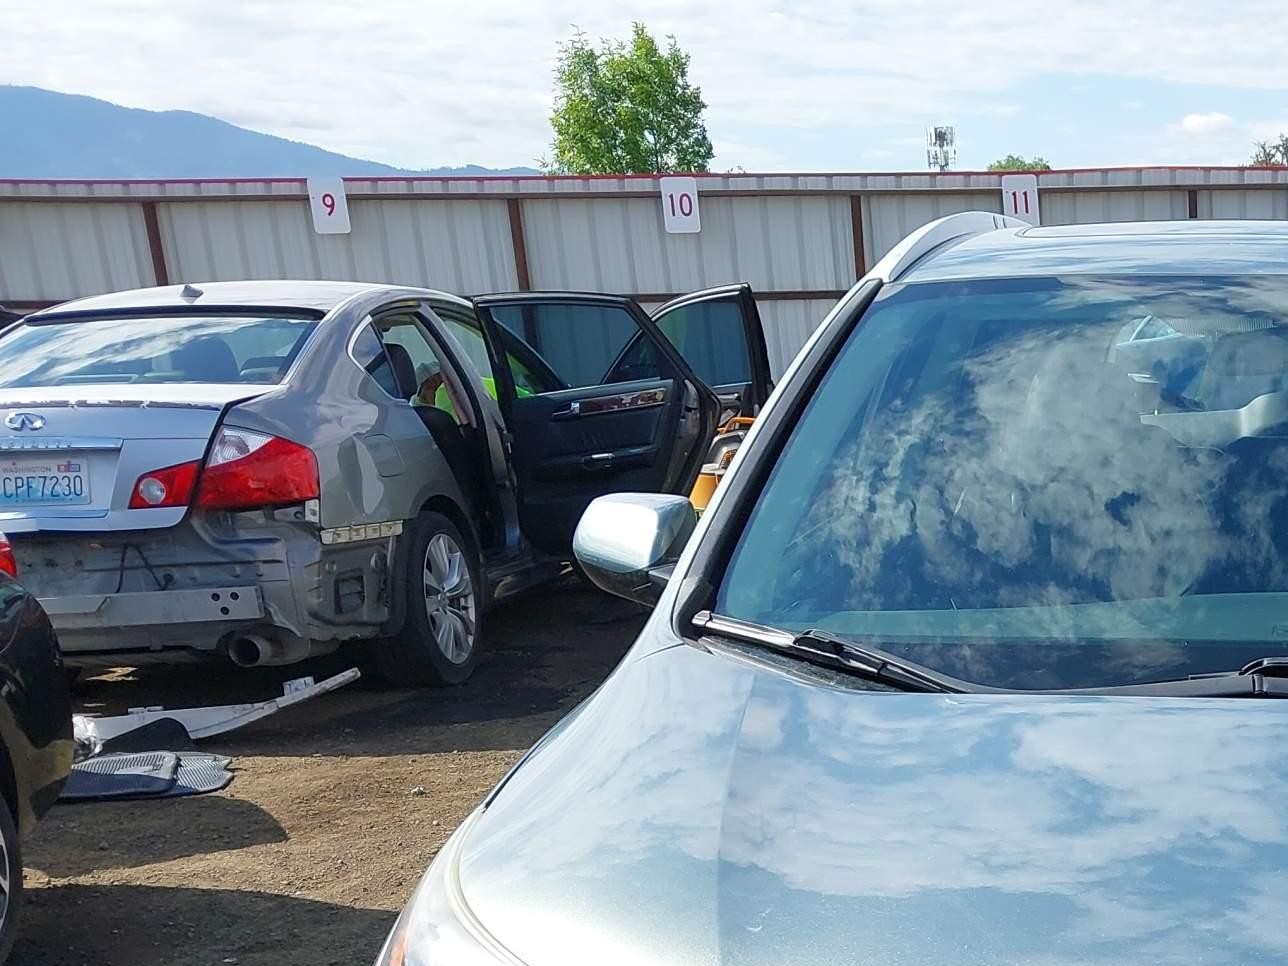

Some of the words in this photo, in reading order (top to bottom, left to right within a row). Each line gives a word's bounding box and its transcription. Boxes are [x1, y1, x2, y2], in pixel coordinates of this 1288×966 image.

[322, 193, 335, 217] 9
[668, 193, 693, 217] 10
[1011, 190, 1029, 215] 11
[2, 464, 51, 474] WASHINGTON
[3, 475, 83, 498] CPF7230
